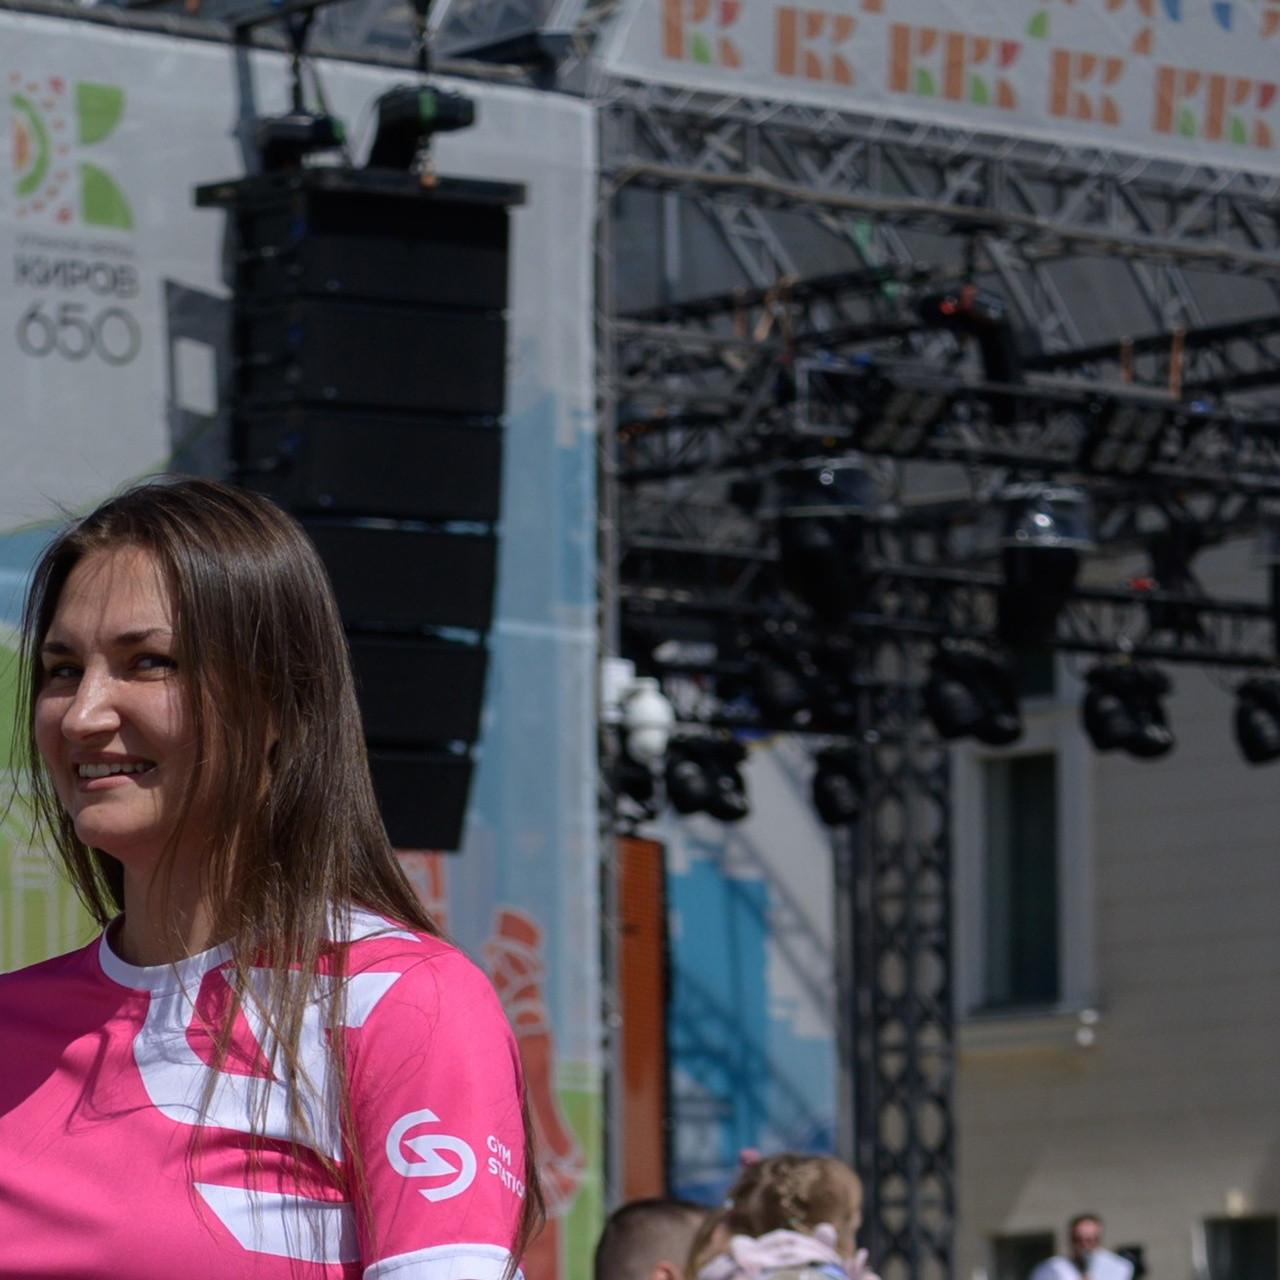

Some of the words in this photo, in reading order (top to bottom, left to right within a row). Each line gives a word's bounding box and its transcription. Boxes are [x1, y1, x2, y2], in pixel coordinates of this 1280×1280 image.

[15, 254, 140, 298] КИРОВ
[15, 297, 143, 368] 650
[486, 1135, 512, 1167] GYM
[487, 1156, 526, 1199] STATIO
